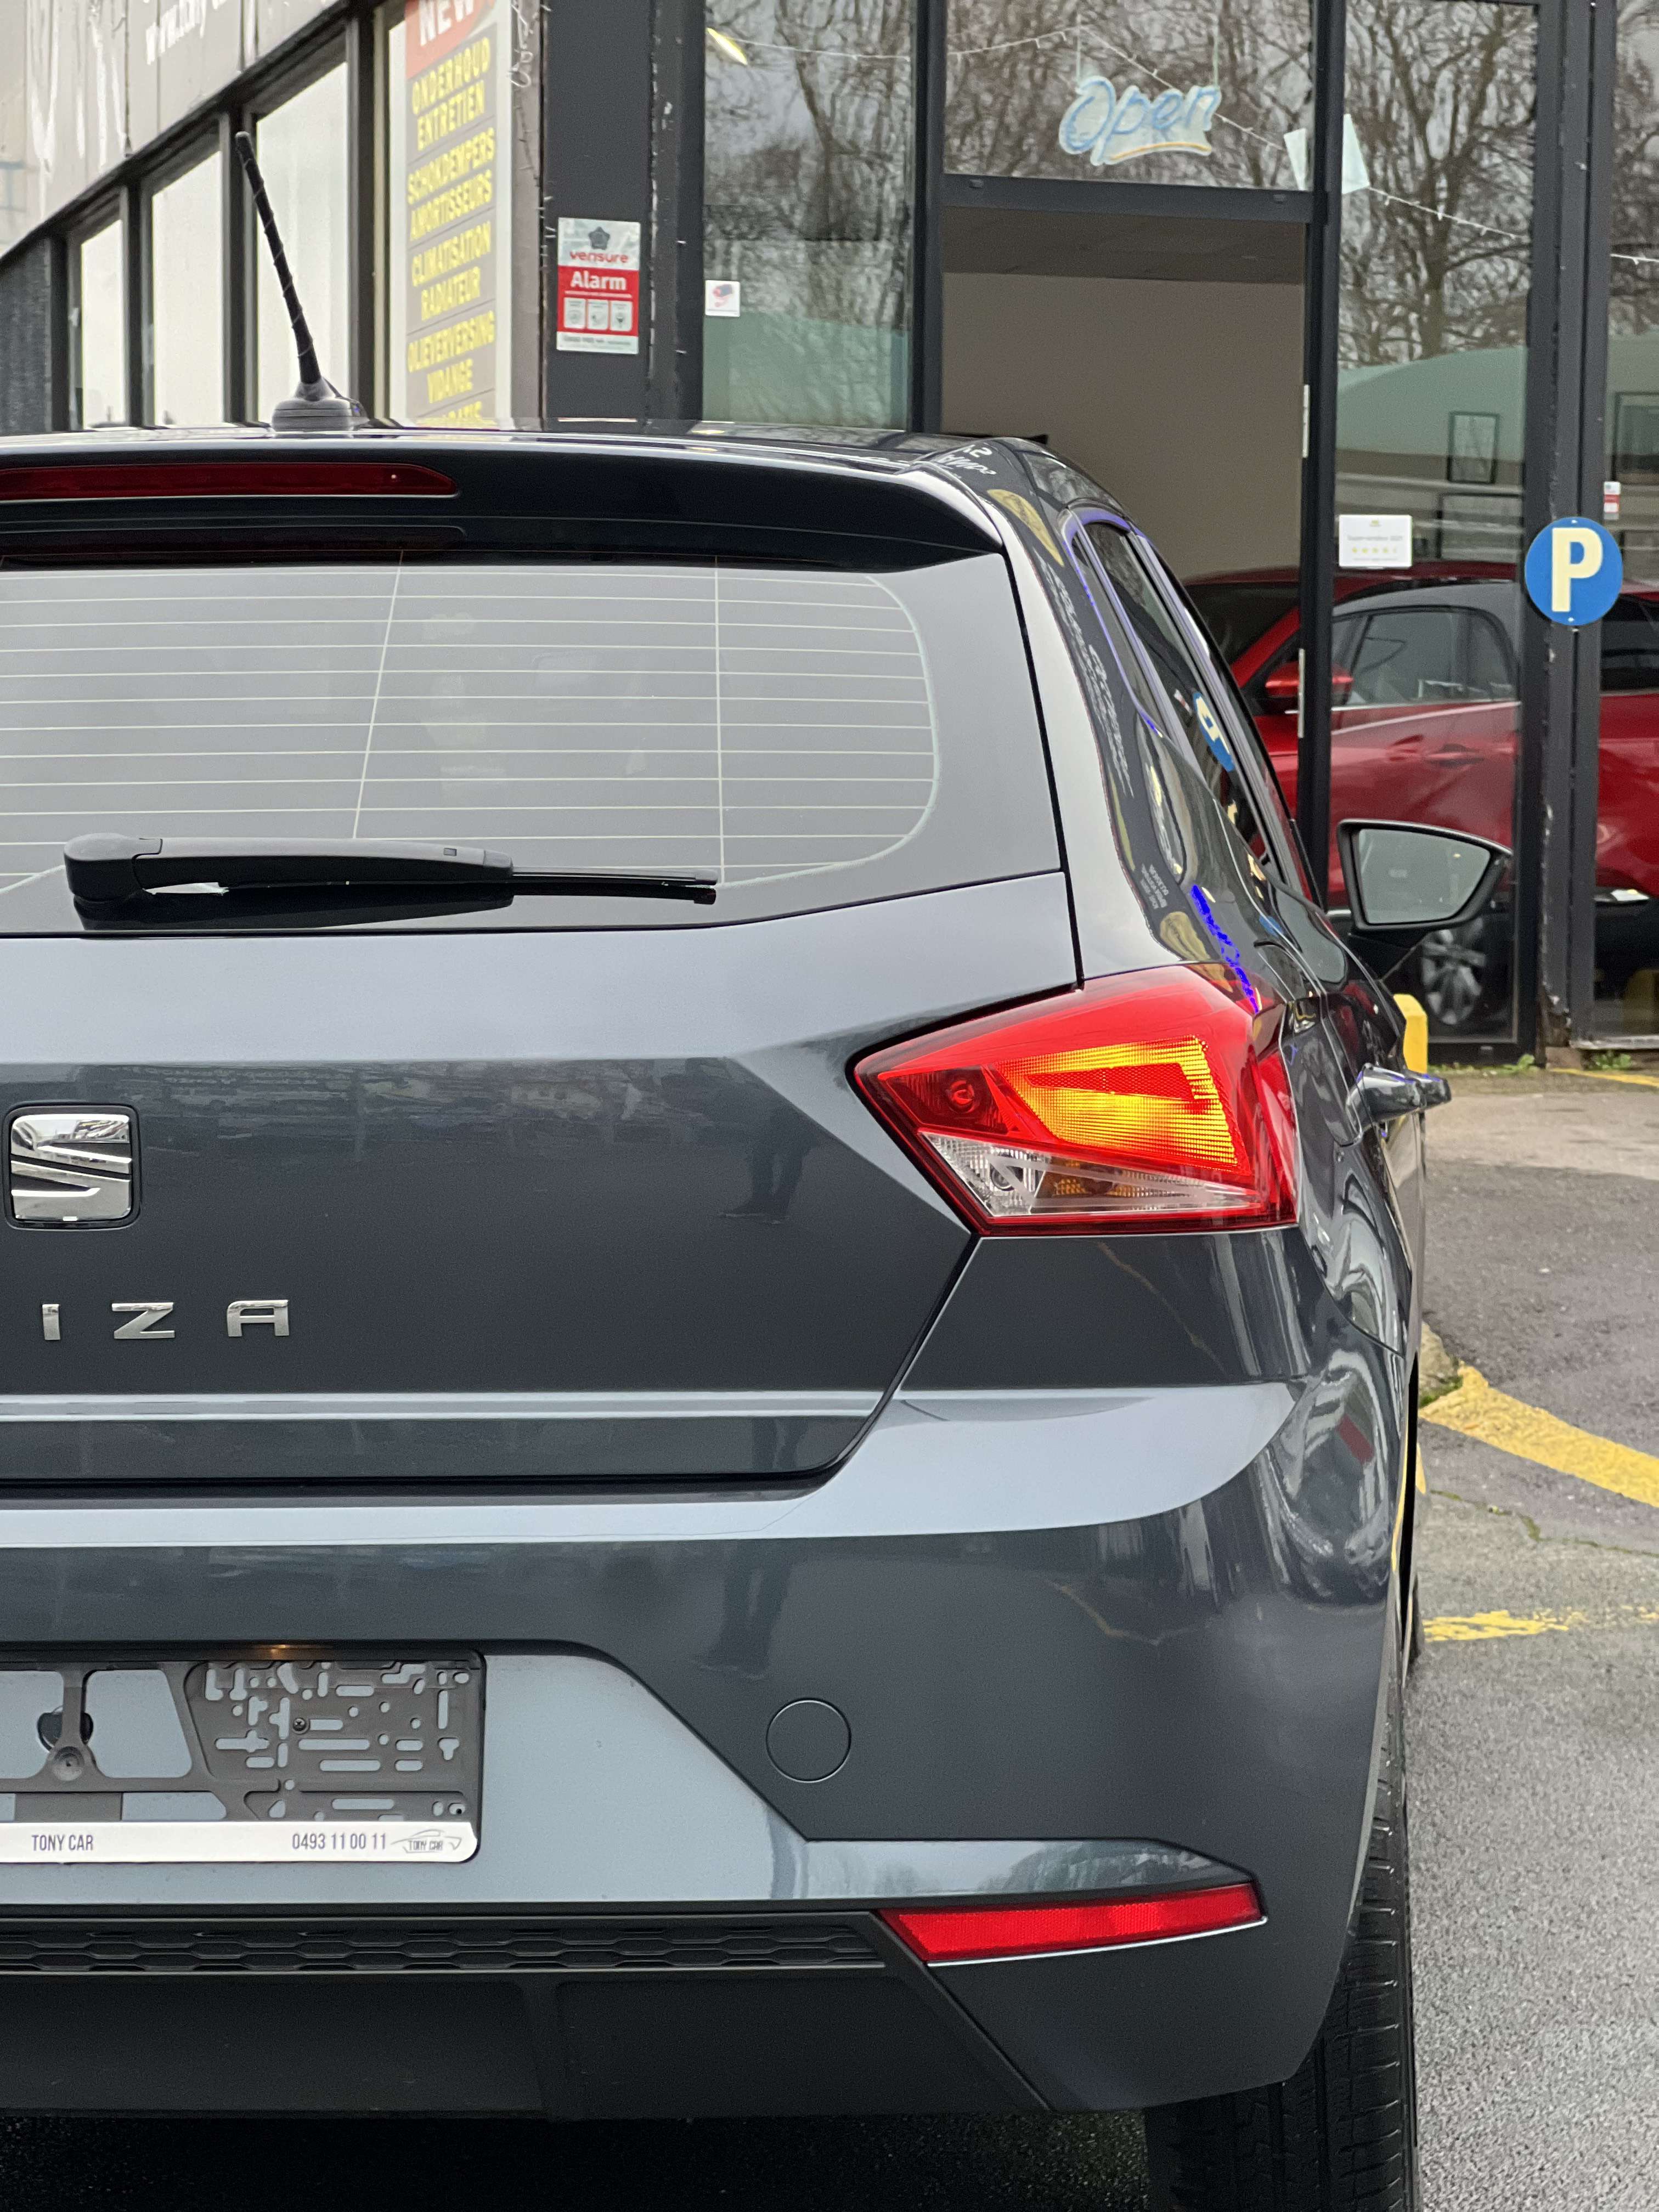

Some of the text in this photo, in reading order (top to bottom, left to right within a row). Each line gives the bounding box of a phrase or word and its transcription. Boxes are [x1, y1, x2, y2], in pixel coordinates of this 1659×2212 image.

[1059, 76, 1221, 165] Open
[571, 271, 627, 291] Alarm
[1551, 527, 1604, 612] P
[31, 1834, 94, 1851] TONY CAR
[292, 1833, 387, 1849] 0493 11 00 11
